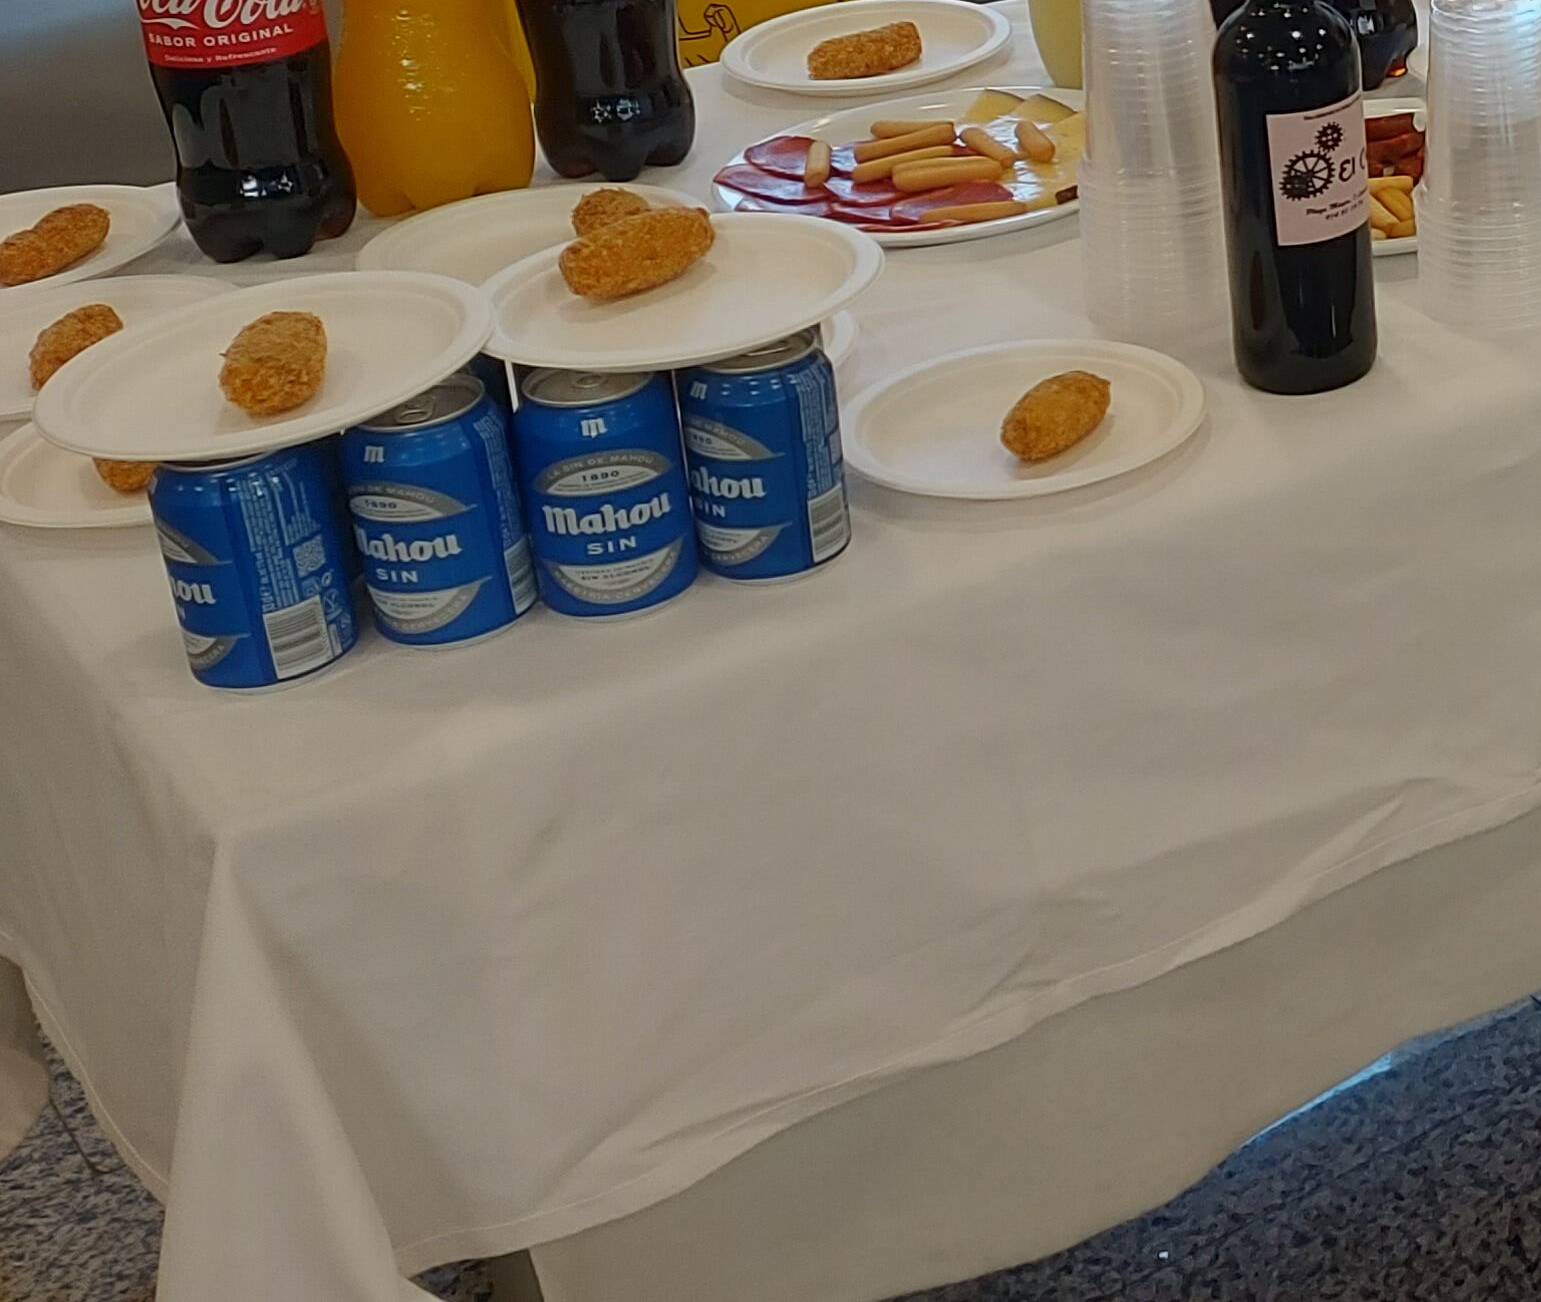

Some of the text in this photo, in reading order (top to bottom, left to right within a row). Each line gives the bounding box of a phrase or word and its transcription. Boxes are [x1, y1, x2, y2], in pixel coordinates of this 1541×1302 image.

[148, 23, 294, 48] SABOR ORIGINAL
[690, 466, 767, 499] ahou
[542, 492, 672, 536] Mahou
[587, 536, 638, 555] SIN
[376, 568, 418, 584] SIN
